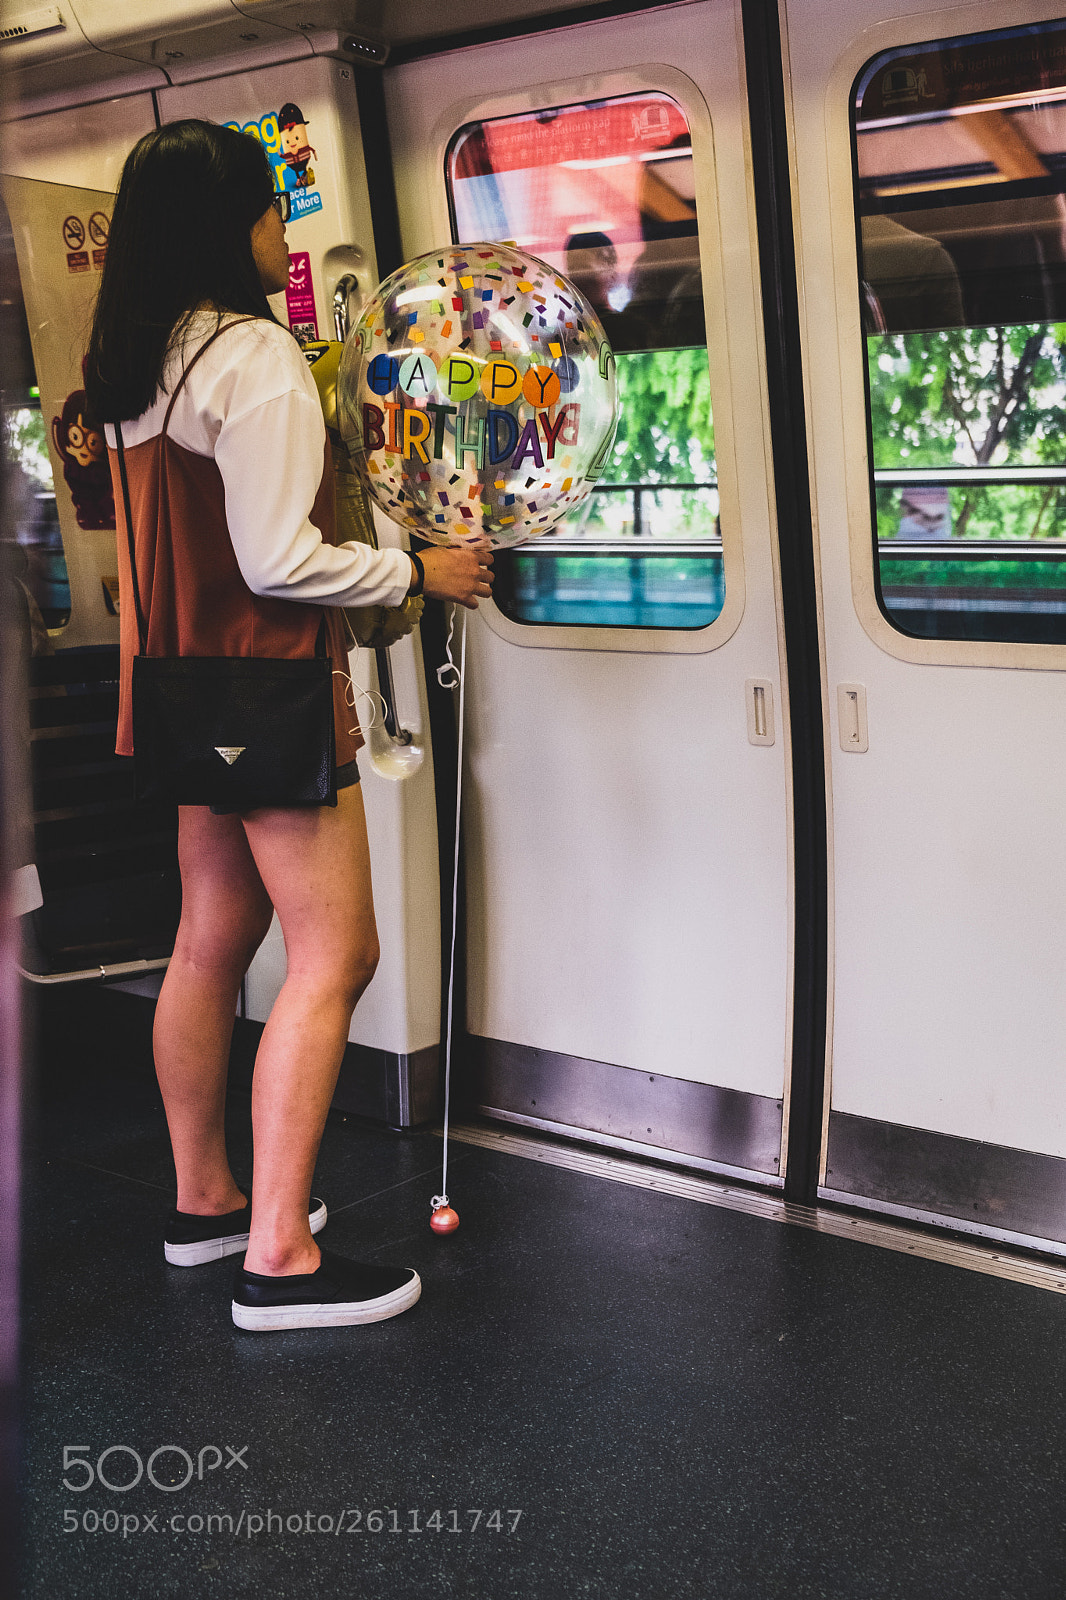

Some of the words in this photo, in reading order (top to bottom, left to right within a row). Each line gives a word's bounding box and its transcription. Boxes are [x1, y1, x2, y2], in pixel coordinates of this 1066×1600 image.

[535, 126, 550, 139] the
[552, 120, 591, 137] platform
[593, 118, 611, 131] gap
[296, 195, 320, 211] More
[371, 356, 555, 404] HAPPY
[363, 402, 566, 470] BIRTHDAY
